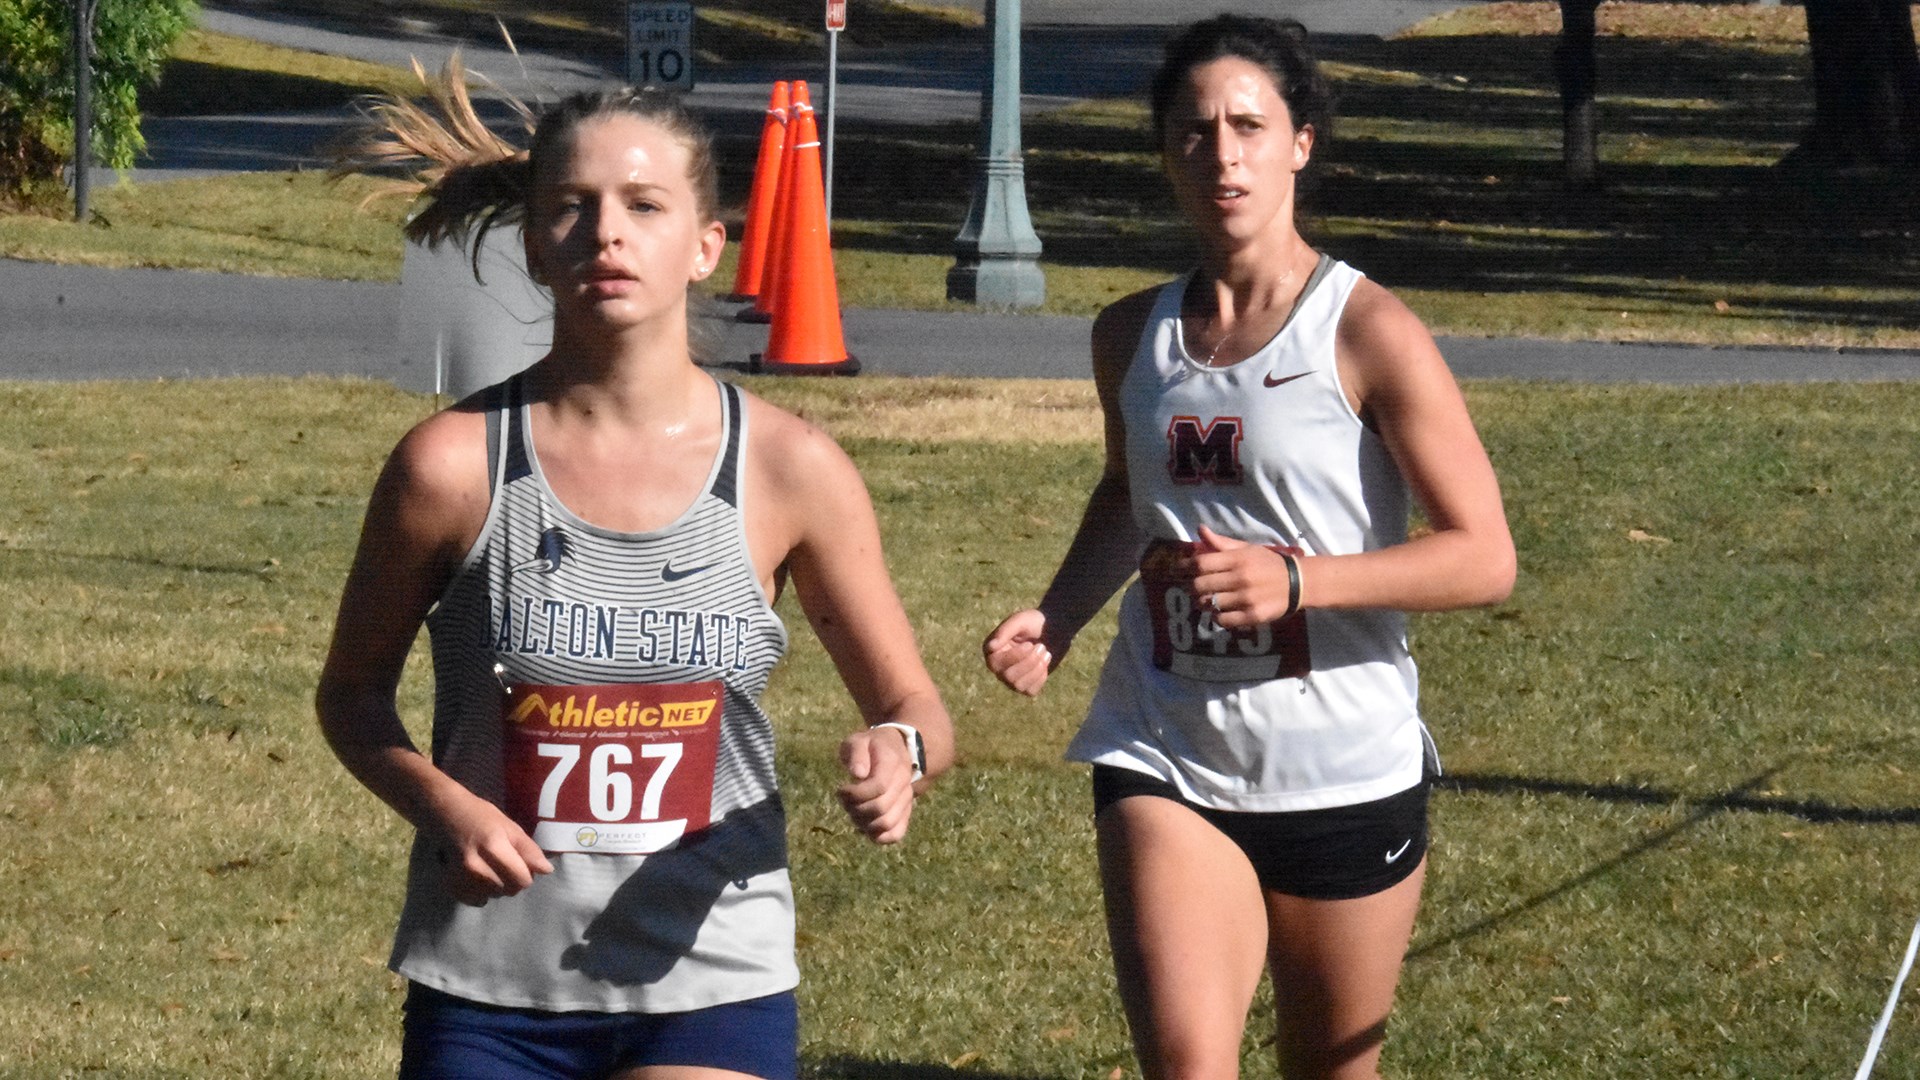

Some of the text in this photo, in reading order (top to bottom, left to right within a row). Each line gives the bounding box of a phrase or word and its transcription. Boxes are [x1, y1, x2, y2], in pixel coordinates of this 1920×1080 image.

[631, 9, 688, 23] SPEED
[636, 29, 680, 43] LIMIT
[639, 49, 684, 82] 10
[1167, 415, 1243, 485] M
[479, 594, 749, 671] DALTON STATE
[507, 693, 709, 728] Athletic NET
[537, 743, 683, 821] 767
